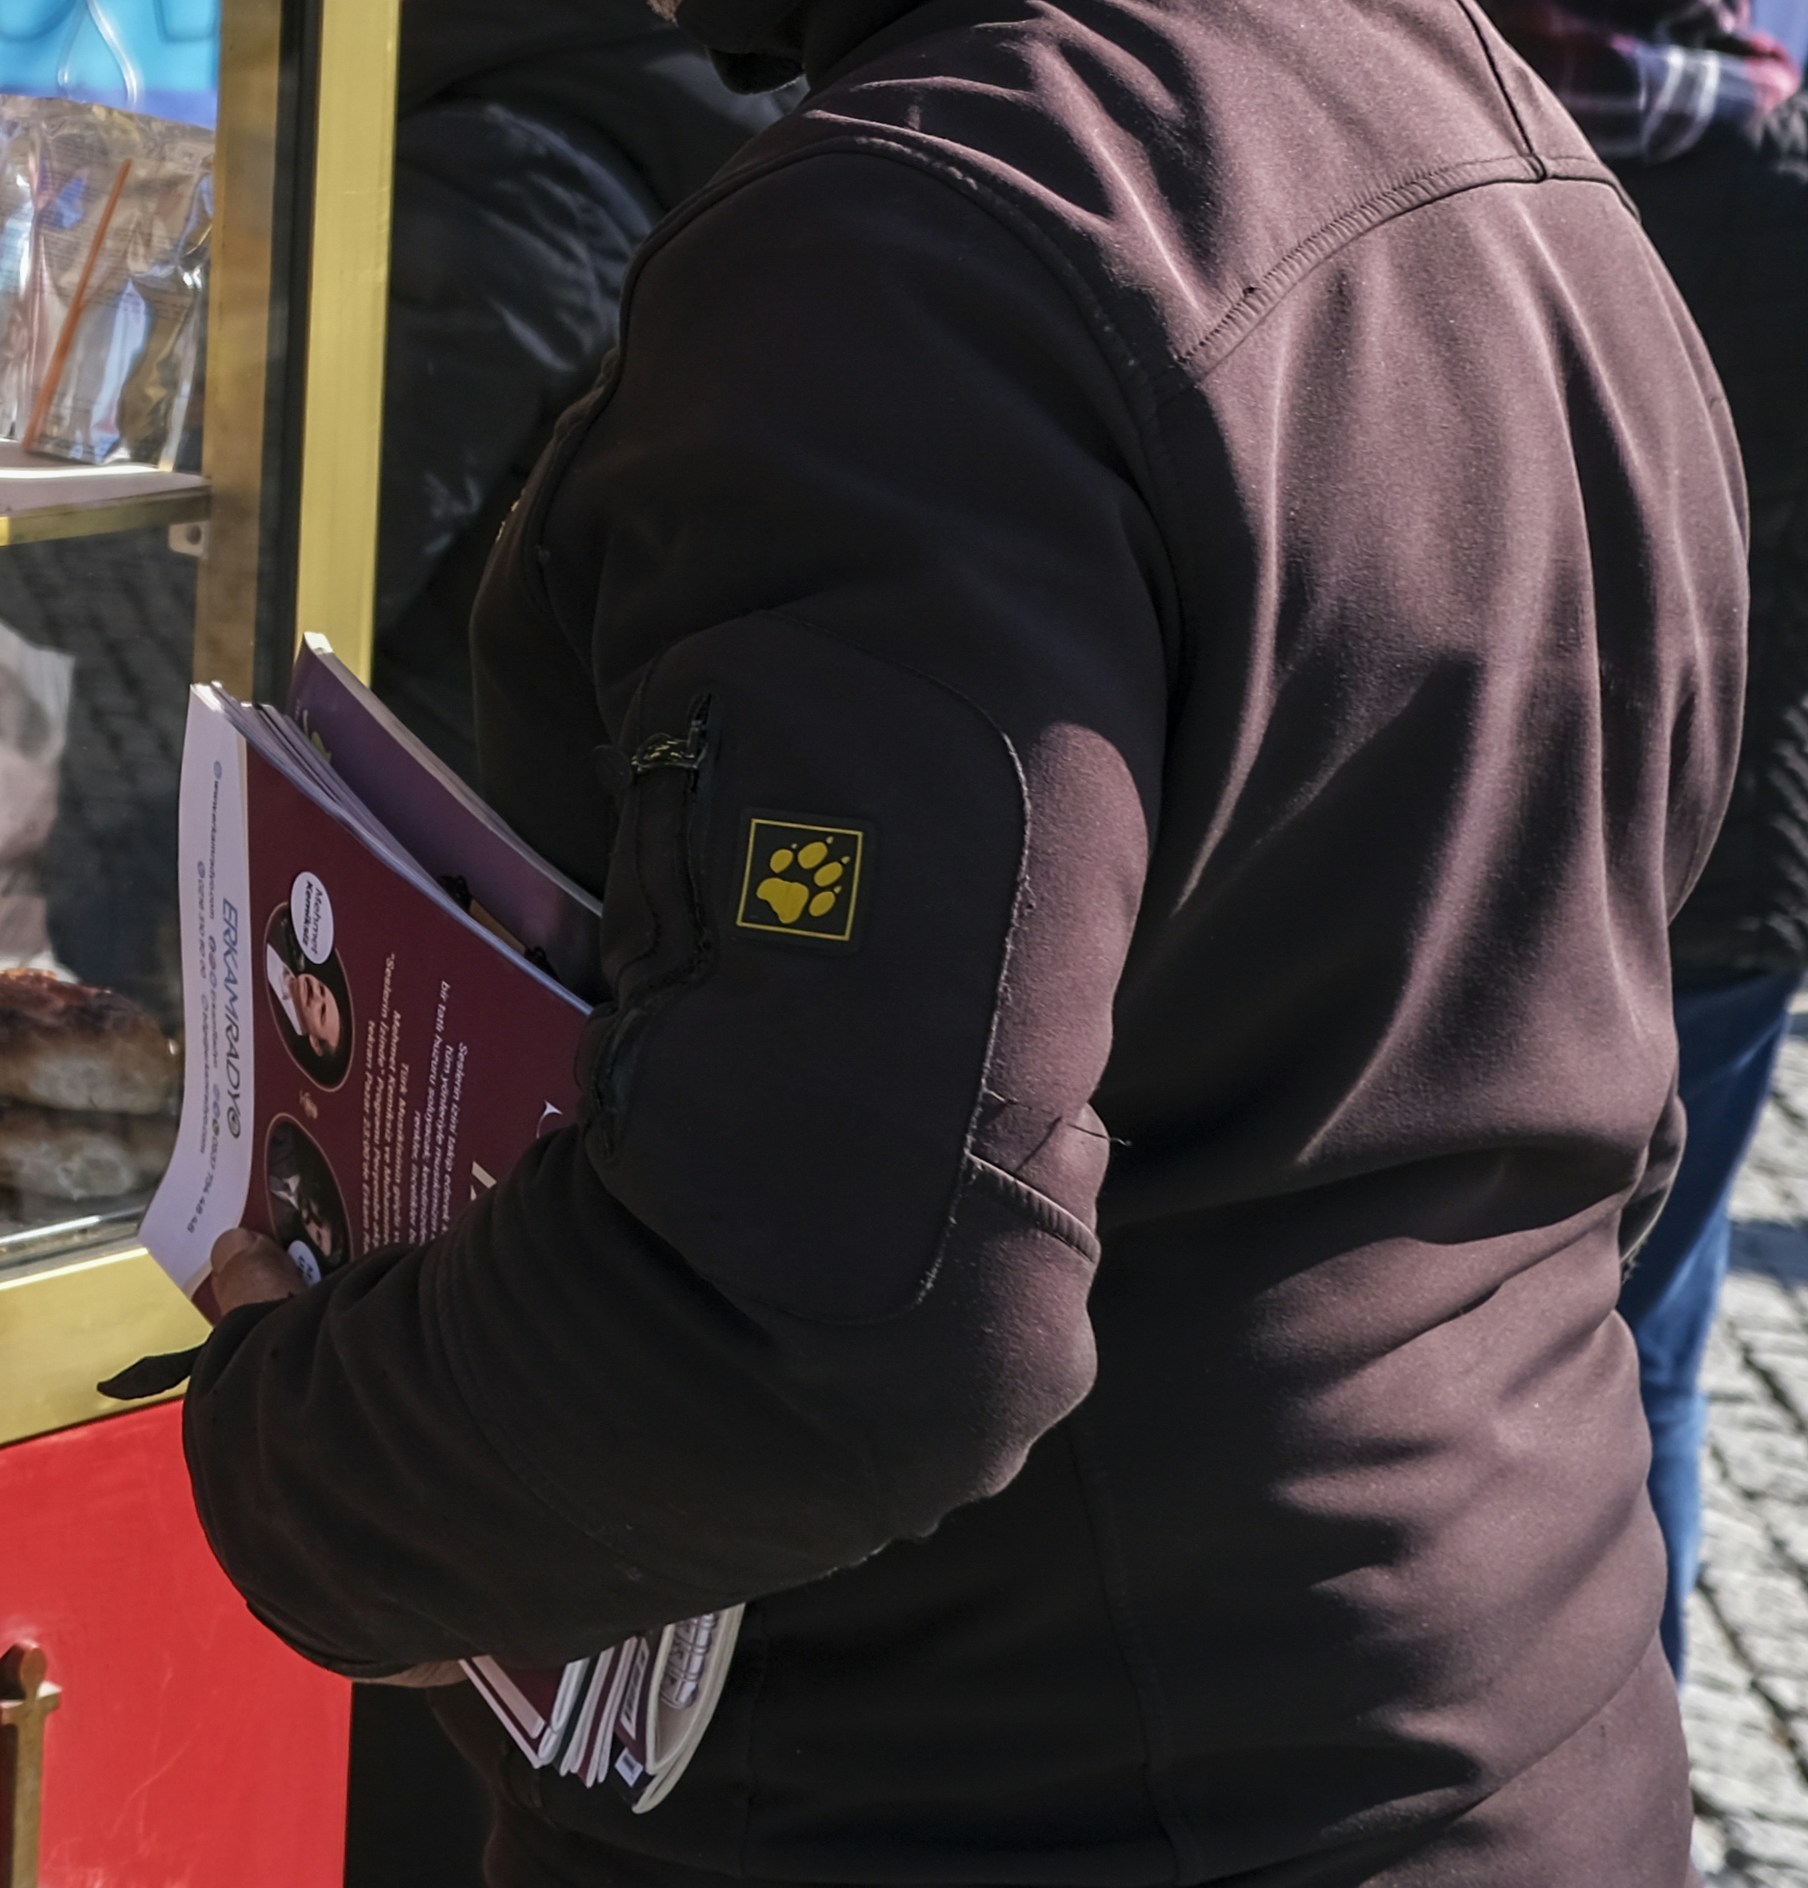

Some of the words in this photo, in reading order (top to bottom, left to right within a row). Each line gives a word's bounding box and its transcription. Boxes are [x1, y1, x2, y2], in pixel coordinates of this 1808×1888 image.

[302, 879, 314, 947] Kemiksiz
[310, 887, 324, 955] Mehmet
[440, 980, 451, 1002] bir
[389, 1010, 401, 1073] Mehmet
[444, 1043, 455, 1073] tüm
[363, 1071, 374, 1114] Pazar
[453, 1042, 469, 1102] Seslerin
[385, 1074, 396, 1143] Kemiksiz
[445, 1136, 456, 1172] takip
